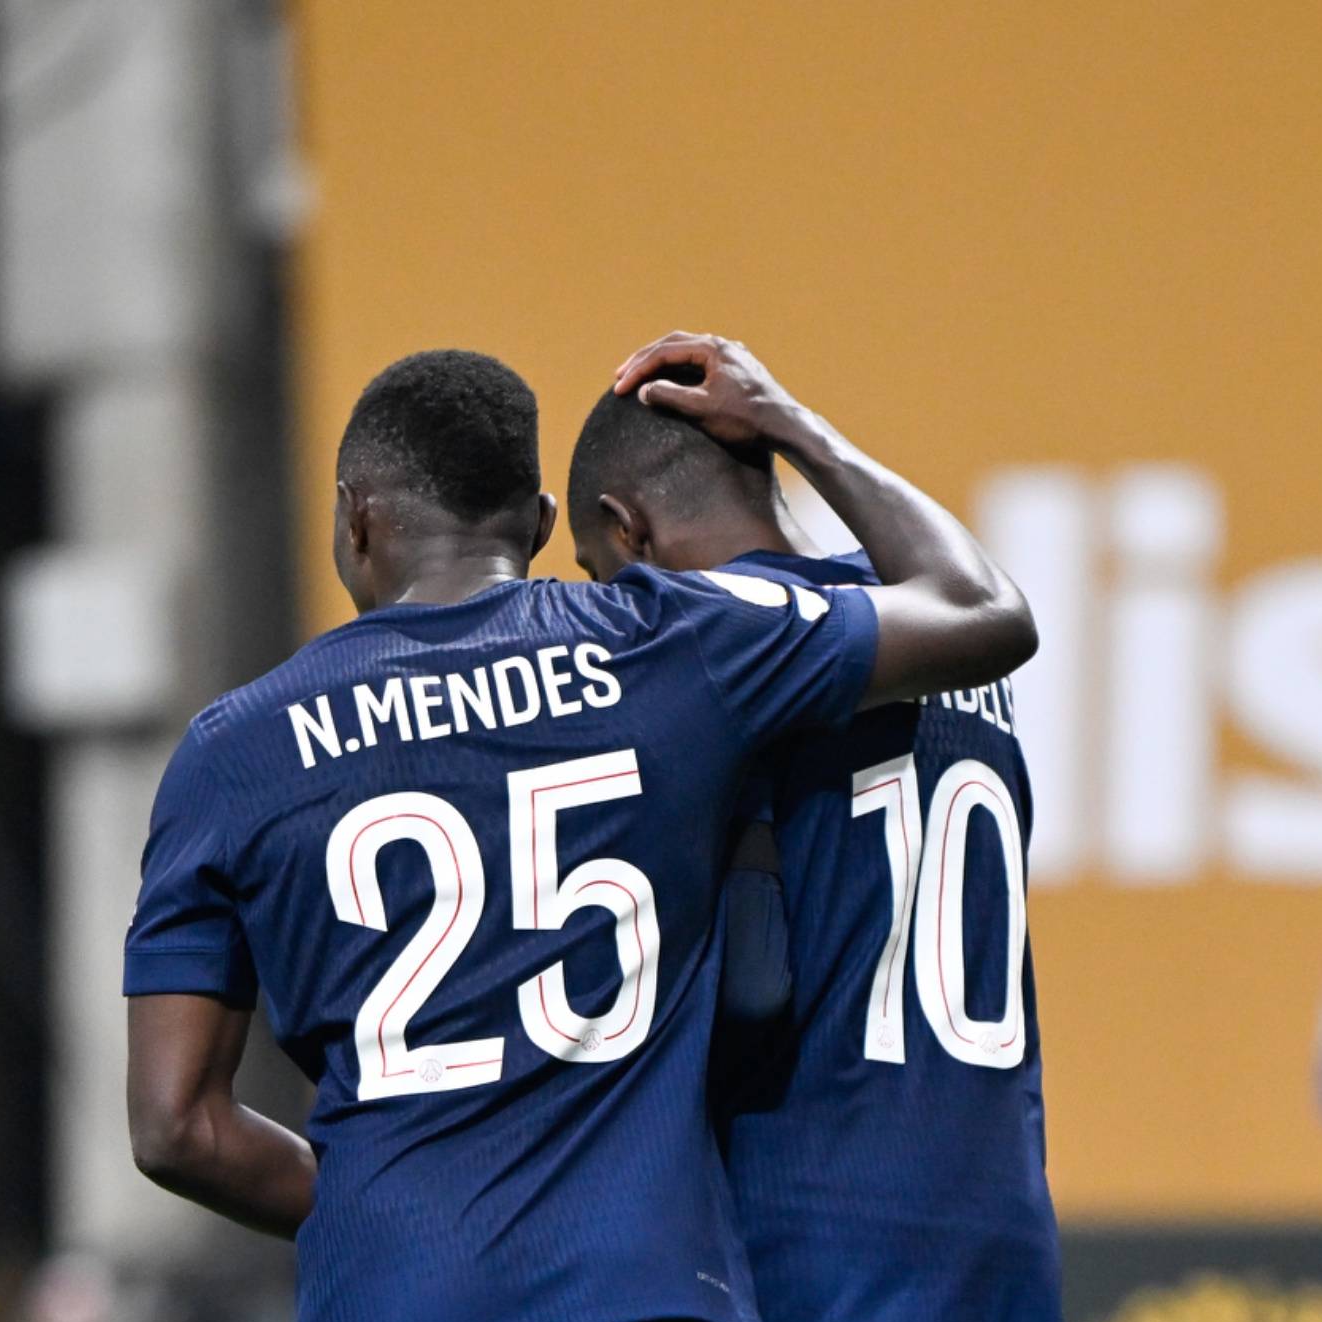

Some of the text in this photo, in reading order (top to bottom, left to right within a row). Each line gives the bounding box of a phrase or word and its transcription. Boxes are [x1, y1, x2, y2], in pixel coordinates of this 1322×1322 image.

[287, 643, 623, 769] N.MENDES
[325, 748, 661, 1101] 25
[851, 751, 1026, 1069] 10
